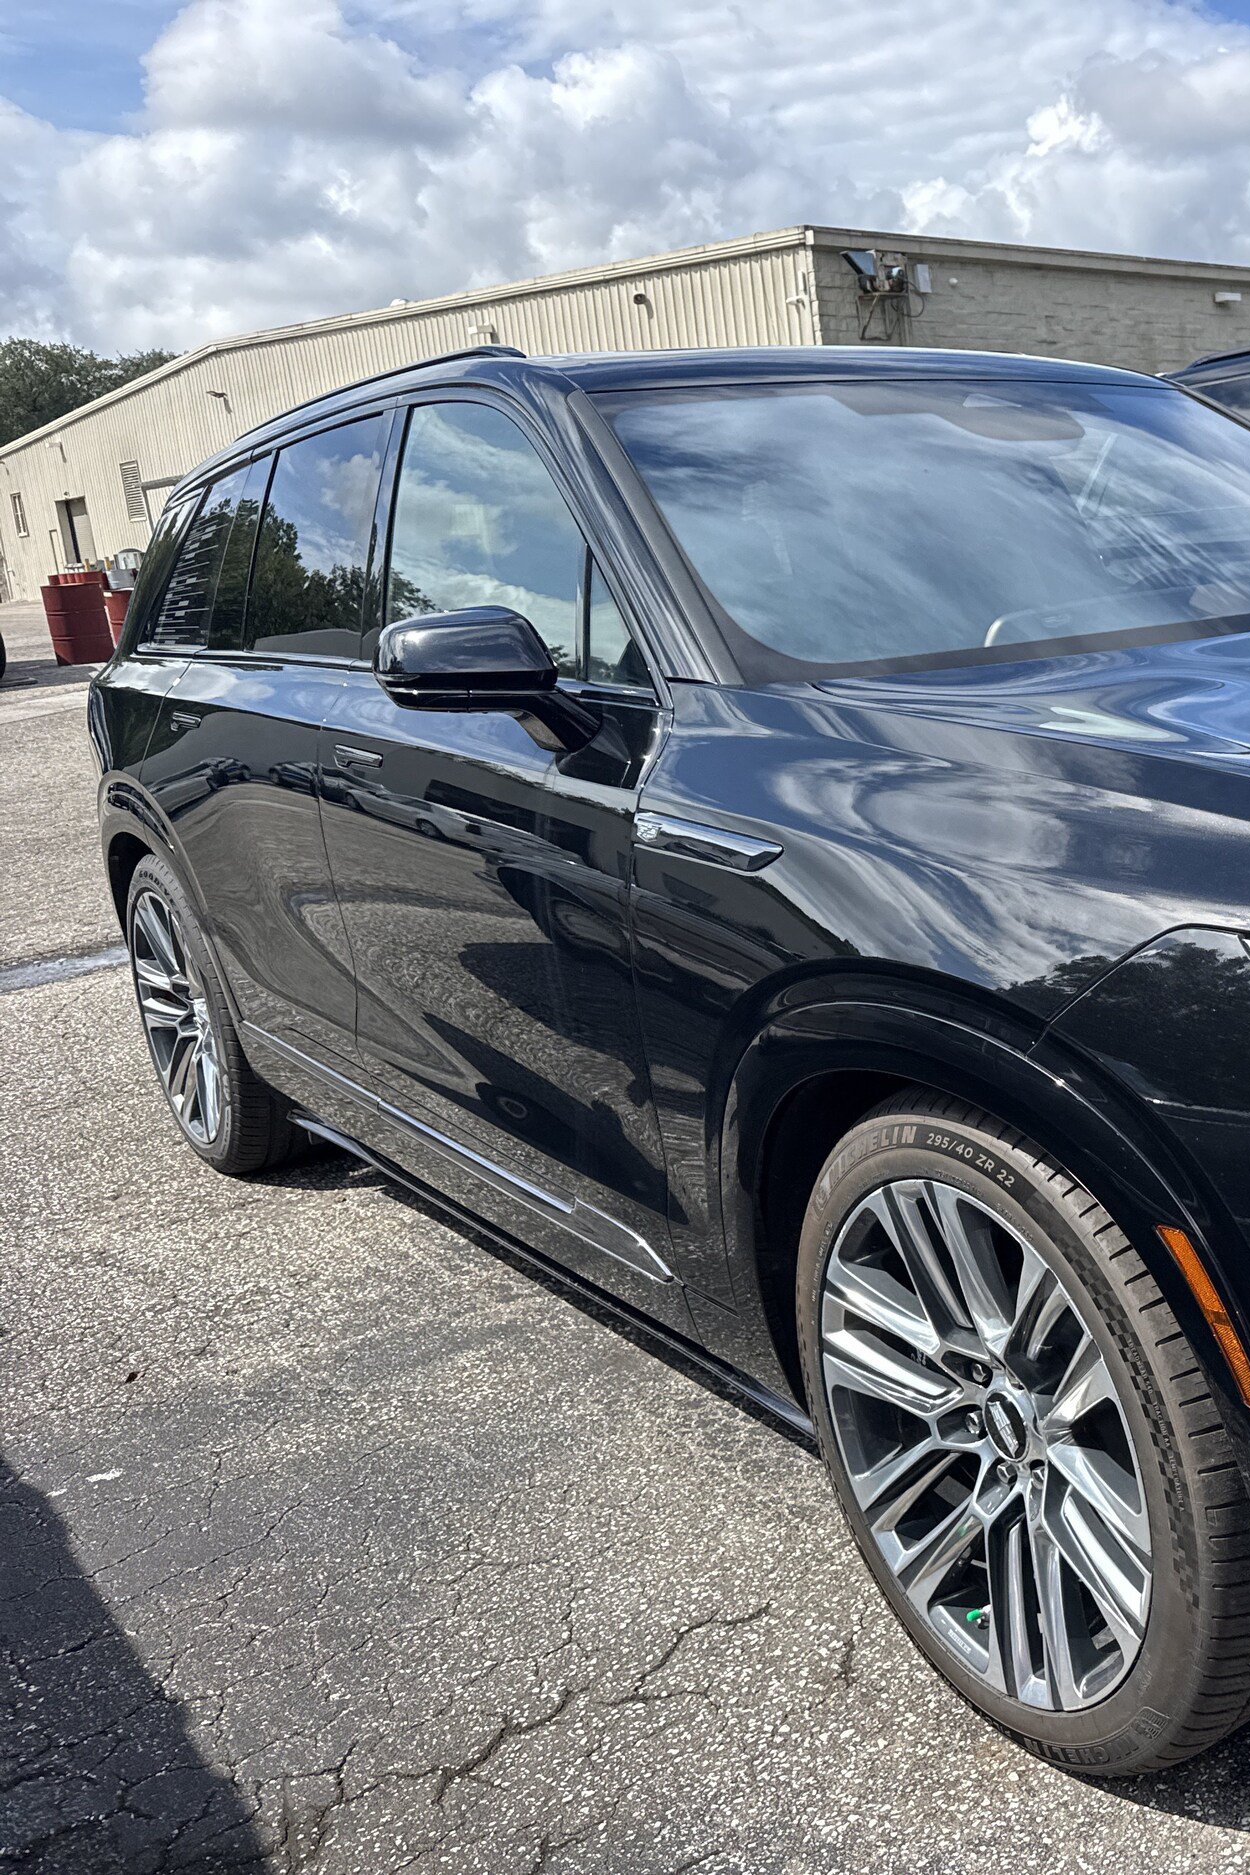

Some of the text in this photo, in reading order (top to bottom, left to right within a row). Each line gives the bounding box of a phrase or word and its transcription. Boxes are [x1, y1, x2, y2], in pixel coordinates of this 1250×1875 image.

[926, 1132, 973, 1160] 295/40
[974, 1152, 994, 1174] ZR
[996, 1168, 1016, 1189] 22
